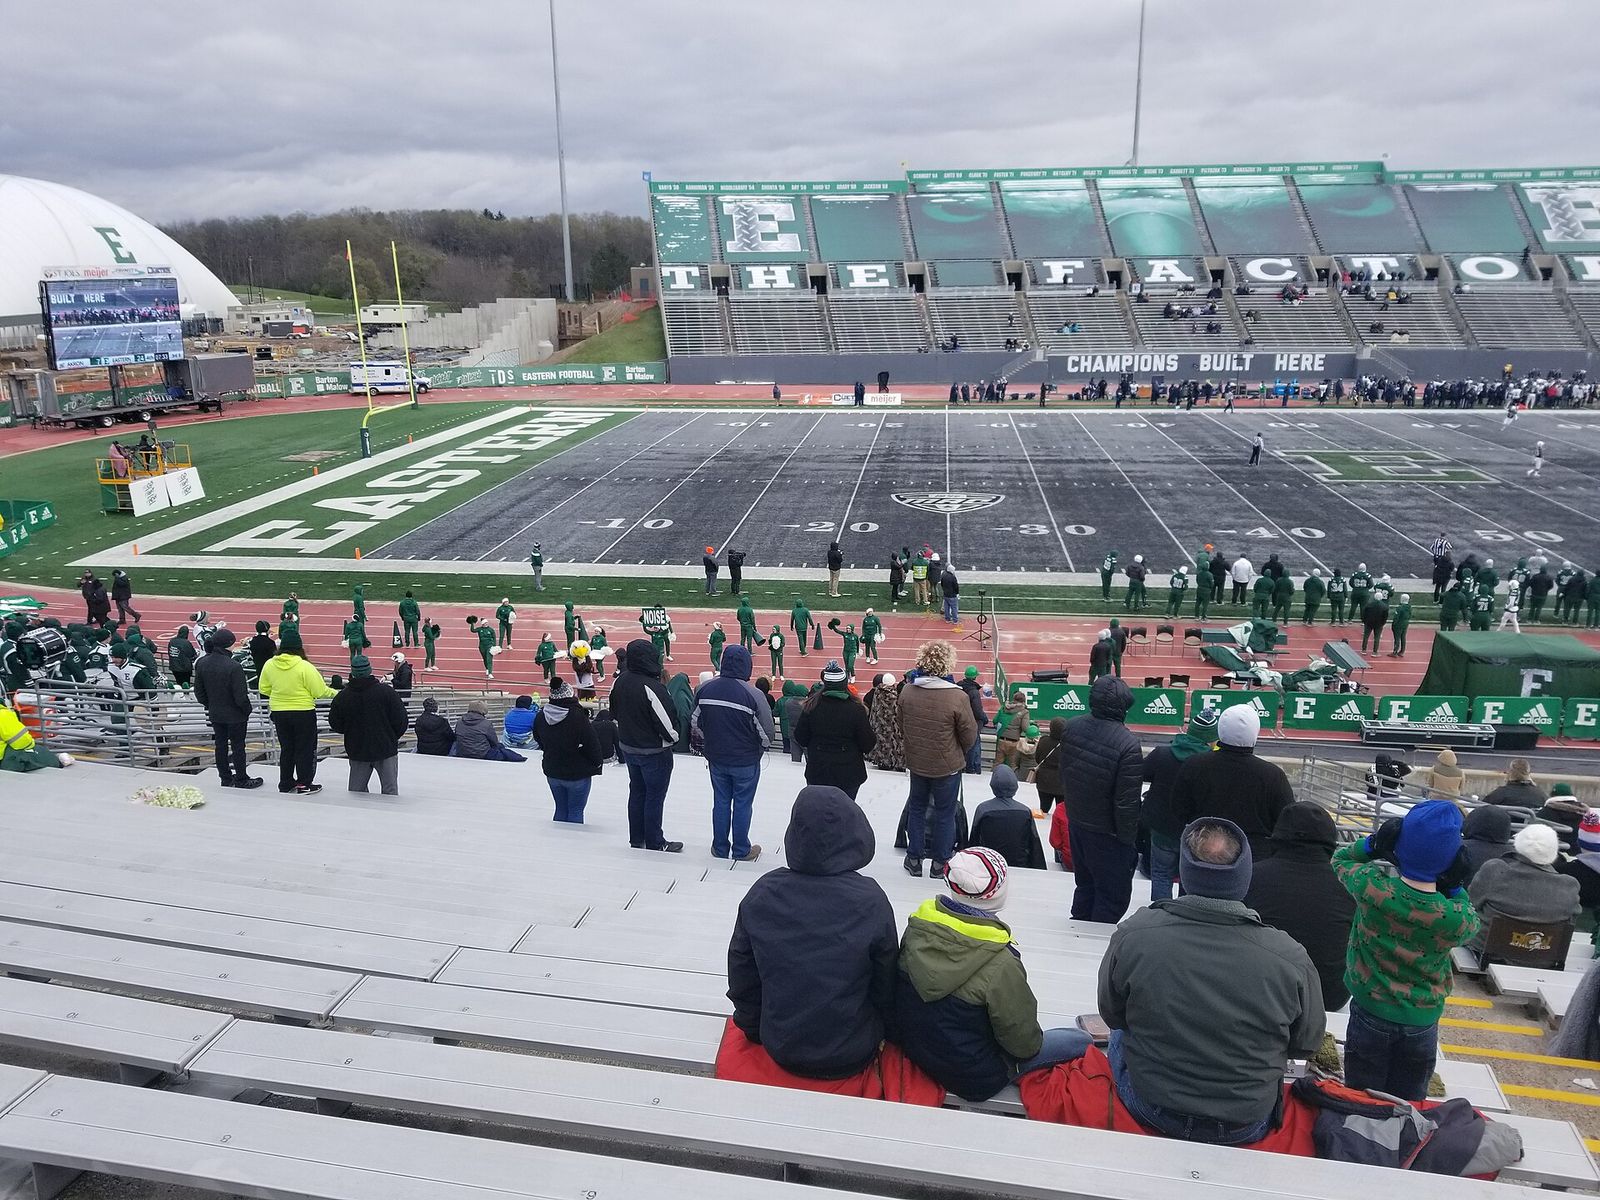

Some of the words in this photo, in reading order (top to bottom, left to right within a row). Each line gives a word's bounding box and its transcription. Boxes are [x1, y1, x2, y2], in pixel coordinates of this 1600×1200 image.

[722, 202, 802, 253] E
[93, 226, 137, 264] E
[83, 267, 108, 277] meijer
[662, 264, 889, 289] THE
[51, 294, 75, 304] BUILT
[84, 293, 106, 303] HERE
[1067, 354, 1178, 373] CHAMPIONS
[1200, 353, 1255, 372] BUILT
[1274, 353, 1326, 372] HERE
[315, 376, 338, 384] Barton
[522, 372, 556, 381] EASTERN
[559, 370, 595, 379] FOOTBALL
[602, 366, 616, 381] E
[289, 377, 306, 394] E
[326, 383, 349, 391] Malow
[870, 393, 897, 403] meijer
[201, 410, 616, 554] EASTERN
[29, 510, 39, 525] E
[1245, 526, 1326, 540] 40
[1474, 529, 1565, 543] 50
[642, 610, 666, 625] NOISE
[124, 673, 131, 681] E
[1053, 702, 1086, 711] adidas
[1143, 704, 1178, 715] adidas
[1201, 695, 1222, 716] E
[1293, 697, 1317, 720] E
[1330, 712, 1365, 722] adidas
[1389, 700, 1411, 722] E
[1424, 714, 1459, 724] adidas
[1483, 701, 1505, 724] E
[1518, 715, 1553, 725] adidas
[1574, 703, 1599, 726] E
